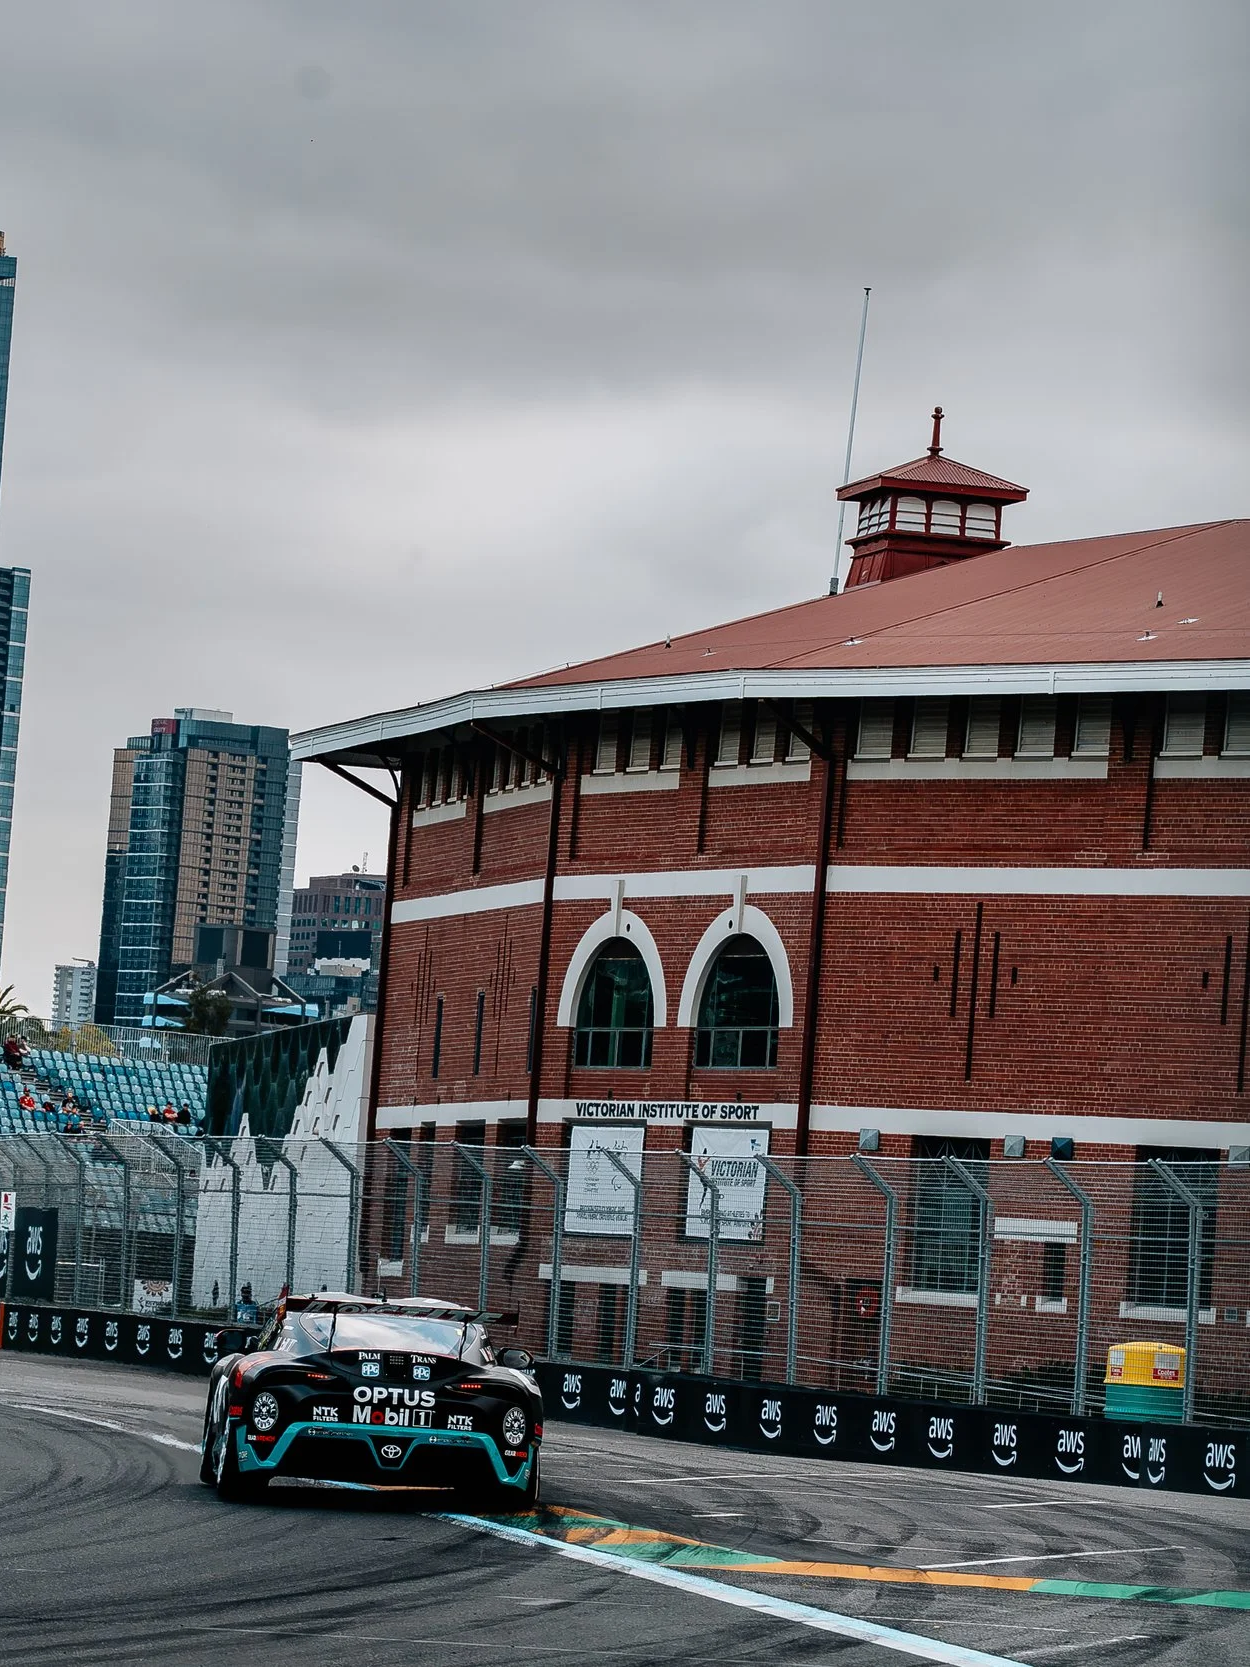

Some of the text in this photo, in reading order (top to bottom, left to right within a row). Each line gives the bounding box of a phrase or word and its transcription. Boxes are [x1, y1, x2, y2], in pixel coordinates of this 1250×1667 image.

[576, 1102, 760, 1120] VICTORIAN INSTITUTE OF SPORT
[711, 1160, 758, 1178] VICTORIAN
[52, 1316, 61, 1330] aws
[77, 1318, 89, 1333] aws
[106, 1321, 118, 1337] aws
[137, 1325, 150, 1340] aws
[169, 1329, 182, 1344] aws
[358, 1352, 380, 1360] PALM
[411, 1354, 436, 1364] TRANS
[363, 1363, 379, 1376] PPG
[414, 1366, 430, 1380] PPG
[563, 1374, 581, 1393] aws
[610, 1378, 626, 1398] aw
[254, 1395, 276, 1412] CHEMICAL
[353, 1386, 435, 1407] OPTUS
[654, 1387, 675, 1408] aws
[706, 1394, 725, 1414] aws
[313, 1406, 338, 1416] NTK
[352, 1405, 409, 1426] Mobil
[448, 1414, 473, 1425] NTK
[762, 1400, 781, 1421] aws
[816, 1405, 837, 1426] aws
[873, 1411, 896, 1433] aws
[929, 1417, 953, 1440] aws
[994, 1424, 1016, 1447] aws
[1058, 1430, 1084, 1454] aws
[1148, 1436, 1166, 1463] aws
[1205, 1442, 1235, 1470] aws
